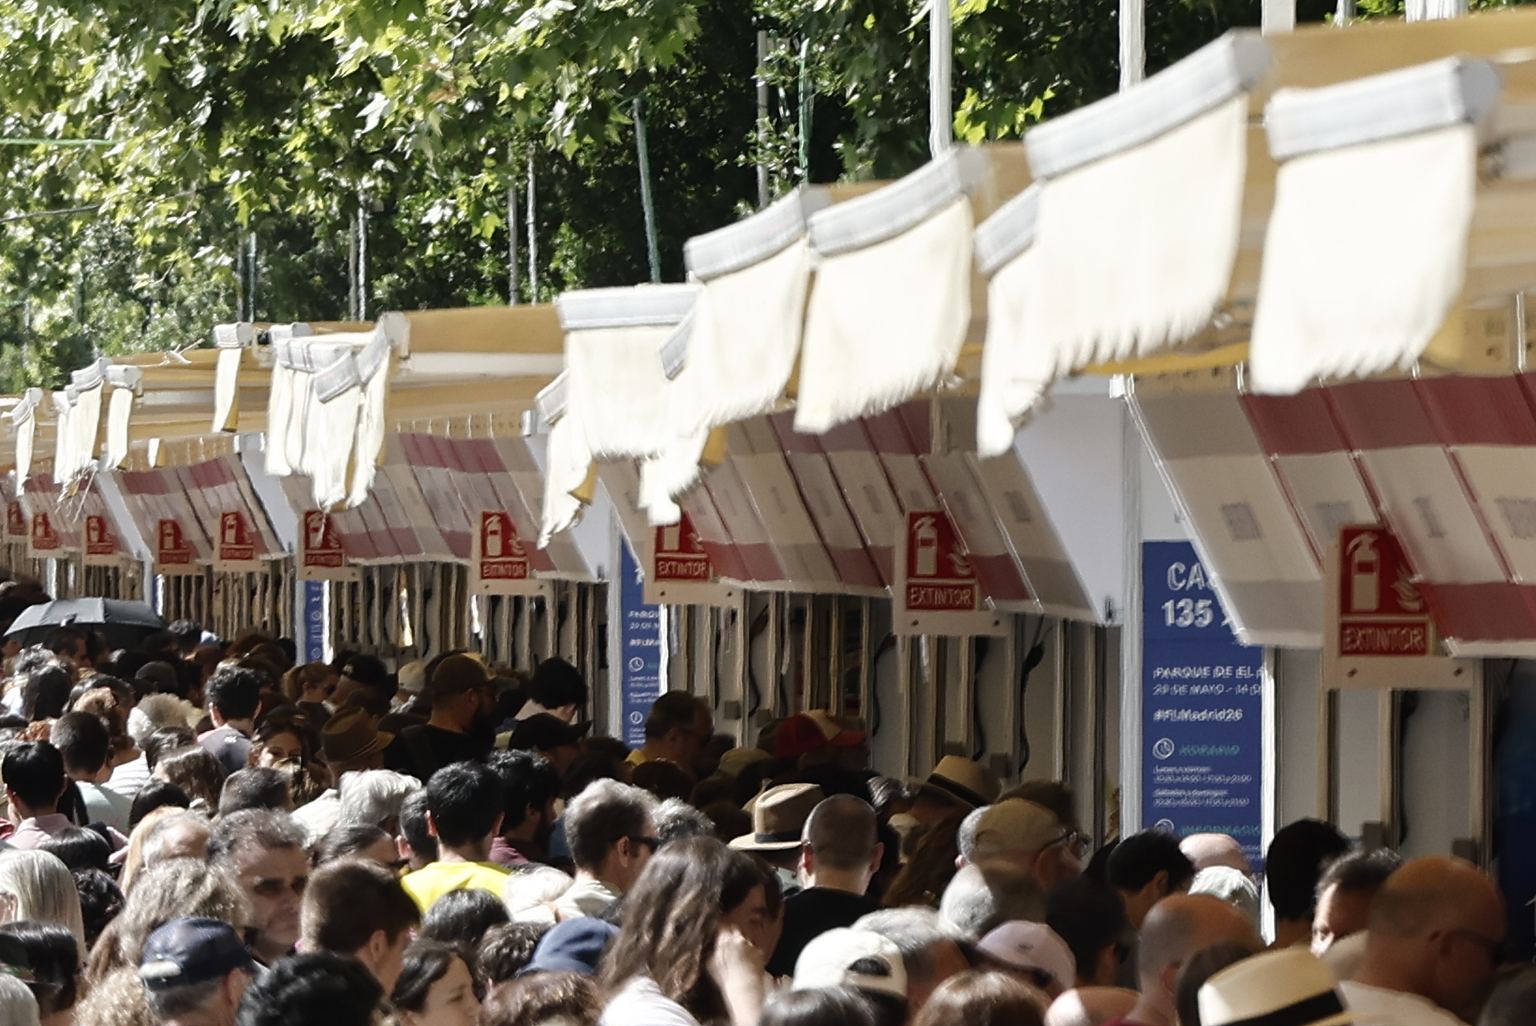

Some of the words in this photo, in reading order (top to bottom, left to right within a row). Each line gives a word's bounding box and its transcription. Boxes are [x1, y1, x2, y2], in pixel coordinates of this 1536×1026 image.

[657, 561, 707, 577] EXTINTOR
[909, 586, 973, 606] EXTINTOR
[1161, 598, 1214, 627] 135
[1343, 627, 1425, 652] EXTINTOR
[1153, 666, 1211, 679] PARQUE
[1213, 665, 1234, 679] DE
[1235, 665, 1254, 679] EL
[1190, 684, 1225, 695] MAYO
[1154, 708, 1244, 722] #FLMadrid26
